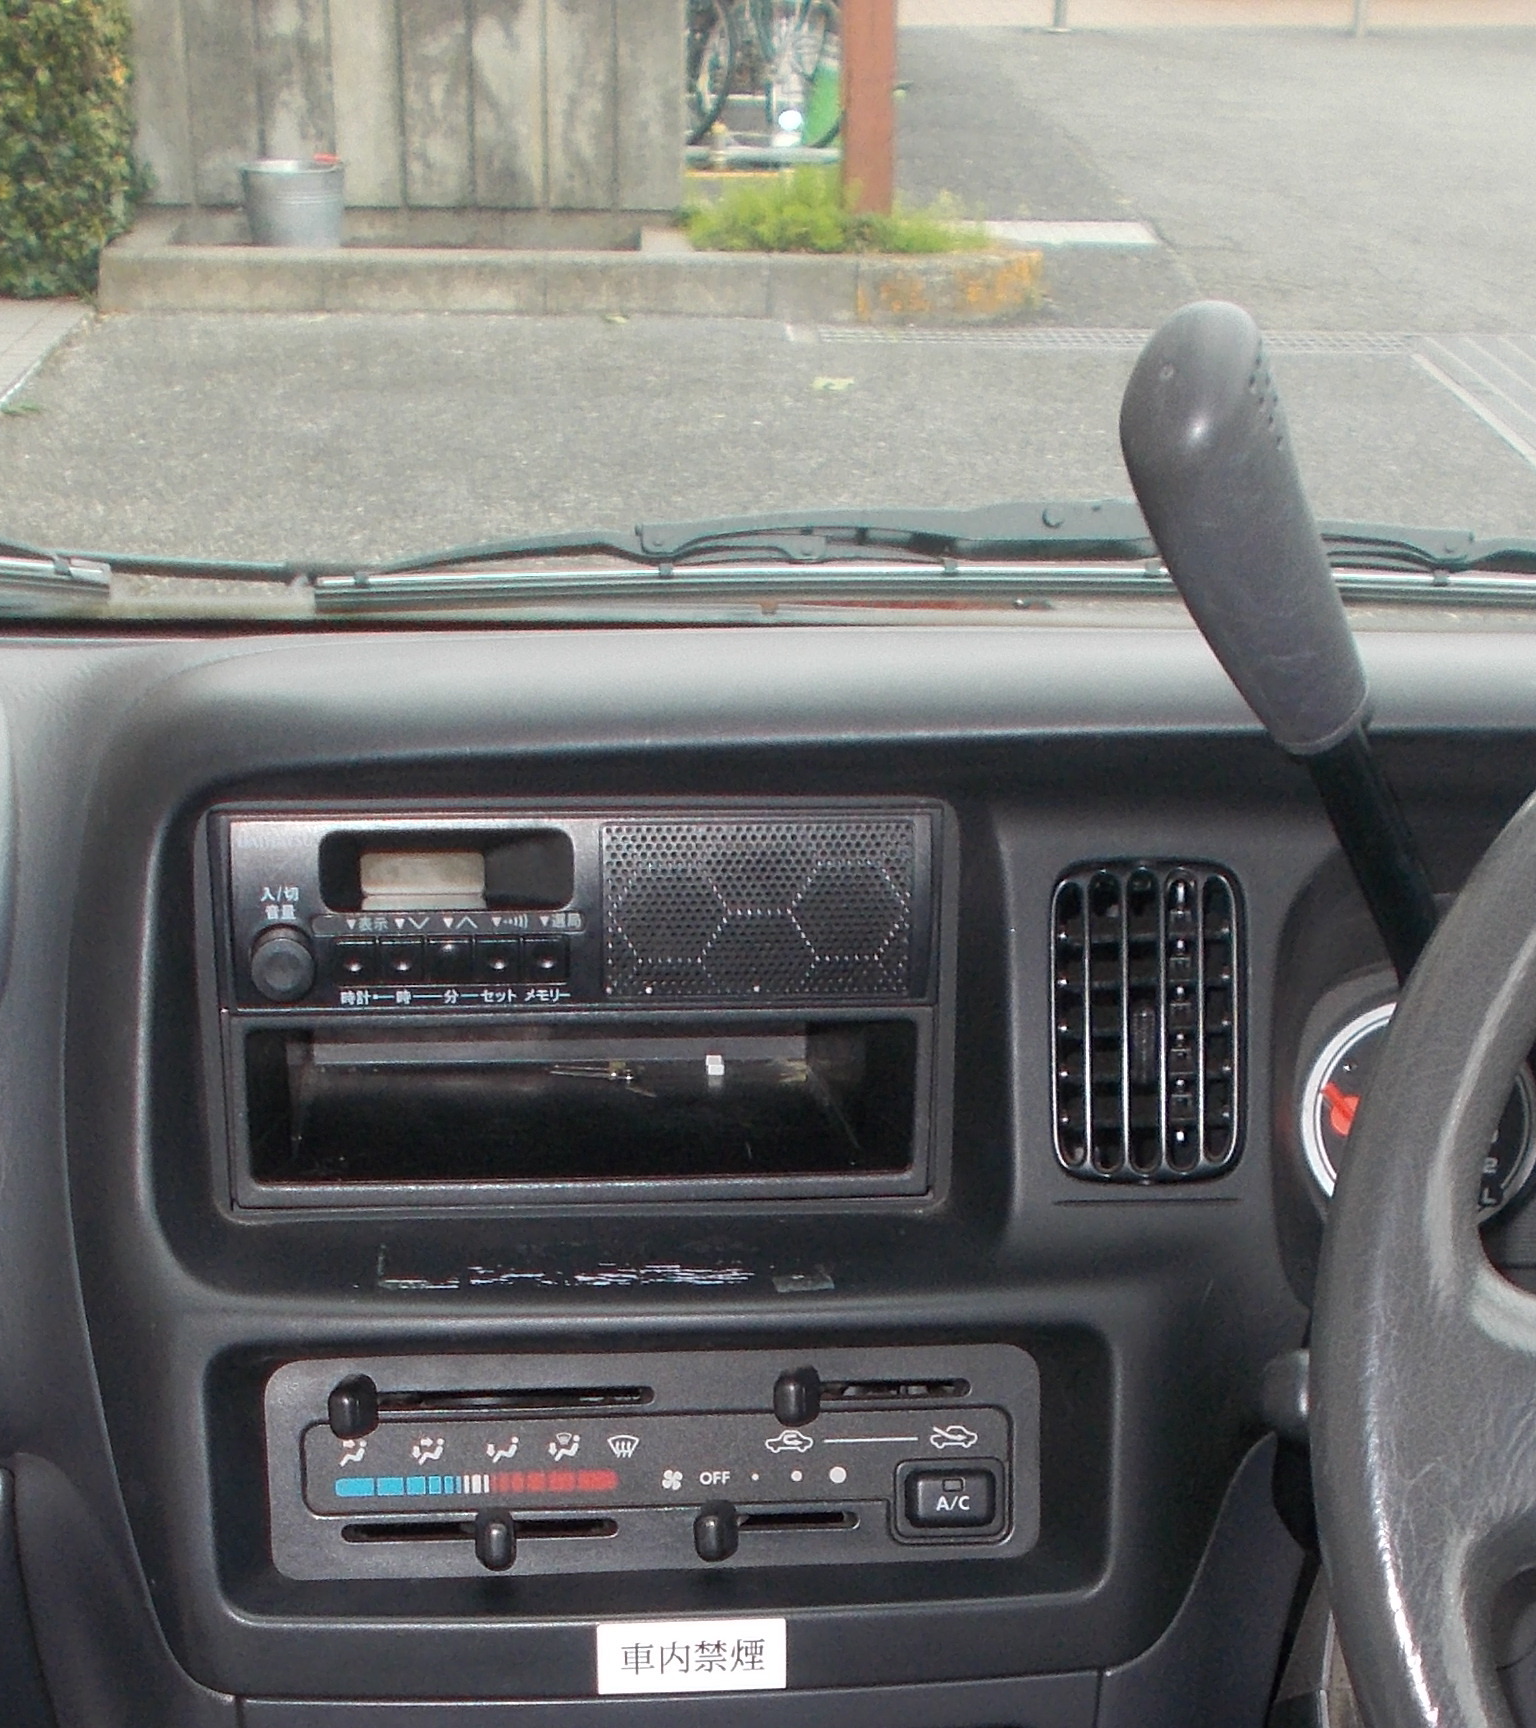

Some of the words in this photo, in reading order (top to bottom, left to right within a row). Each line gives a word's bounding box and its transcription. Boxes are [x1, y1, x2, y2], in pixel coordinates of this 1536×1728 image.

[260, 885, 300, 902] 入/切
[265, 904, 297, 920] 音量
[358, 917, 389, 932] 表示
[340, 990, 370, 1005] 時計
[395, 990, 412, 1005] 時
[443, 990, 460, 1004] 分
[480, 989, 517, 1003] セット
[699, 1470, 731, 1486] OFF
[935, 1495, 971, 1512] A/C
[620, 1637, 766, 1676] 車内禁煙
